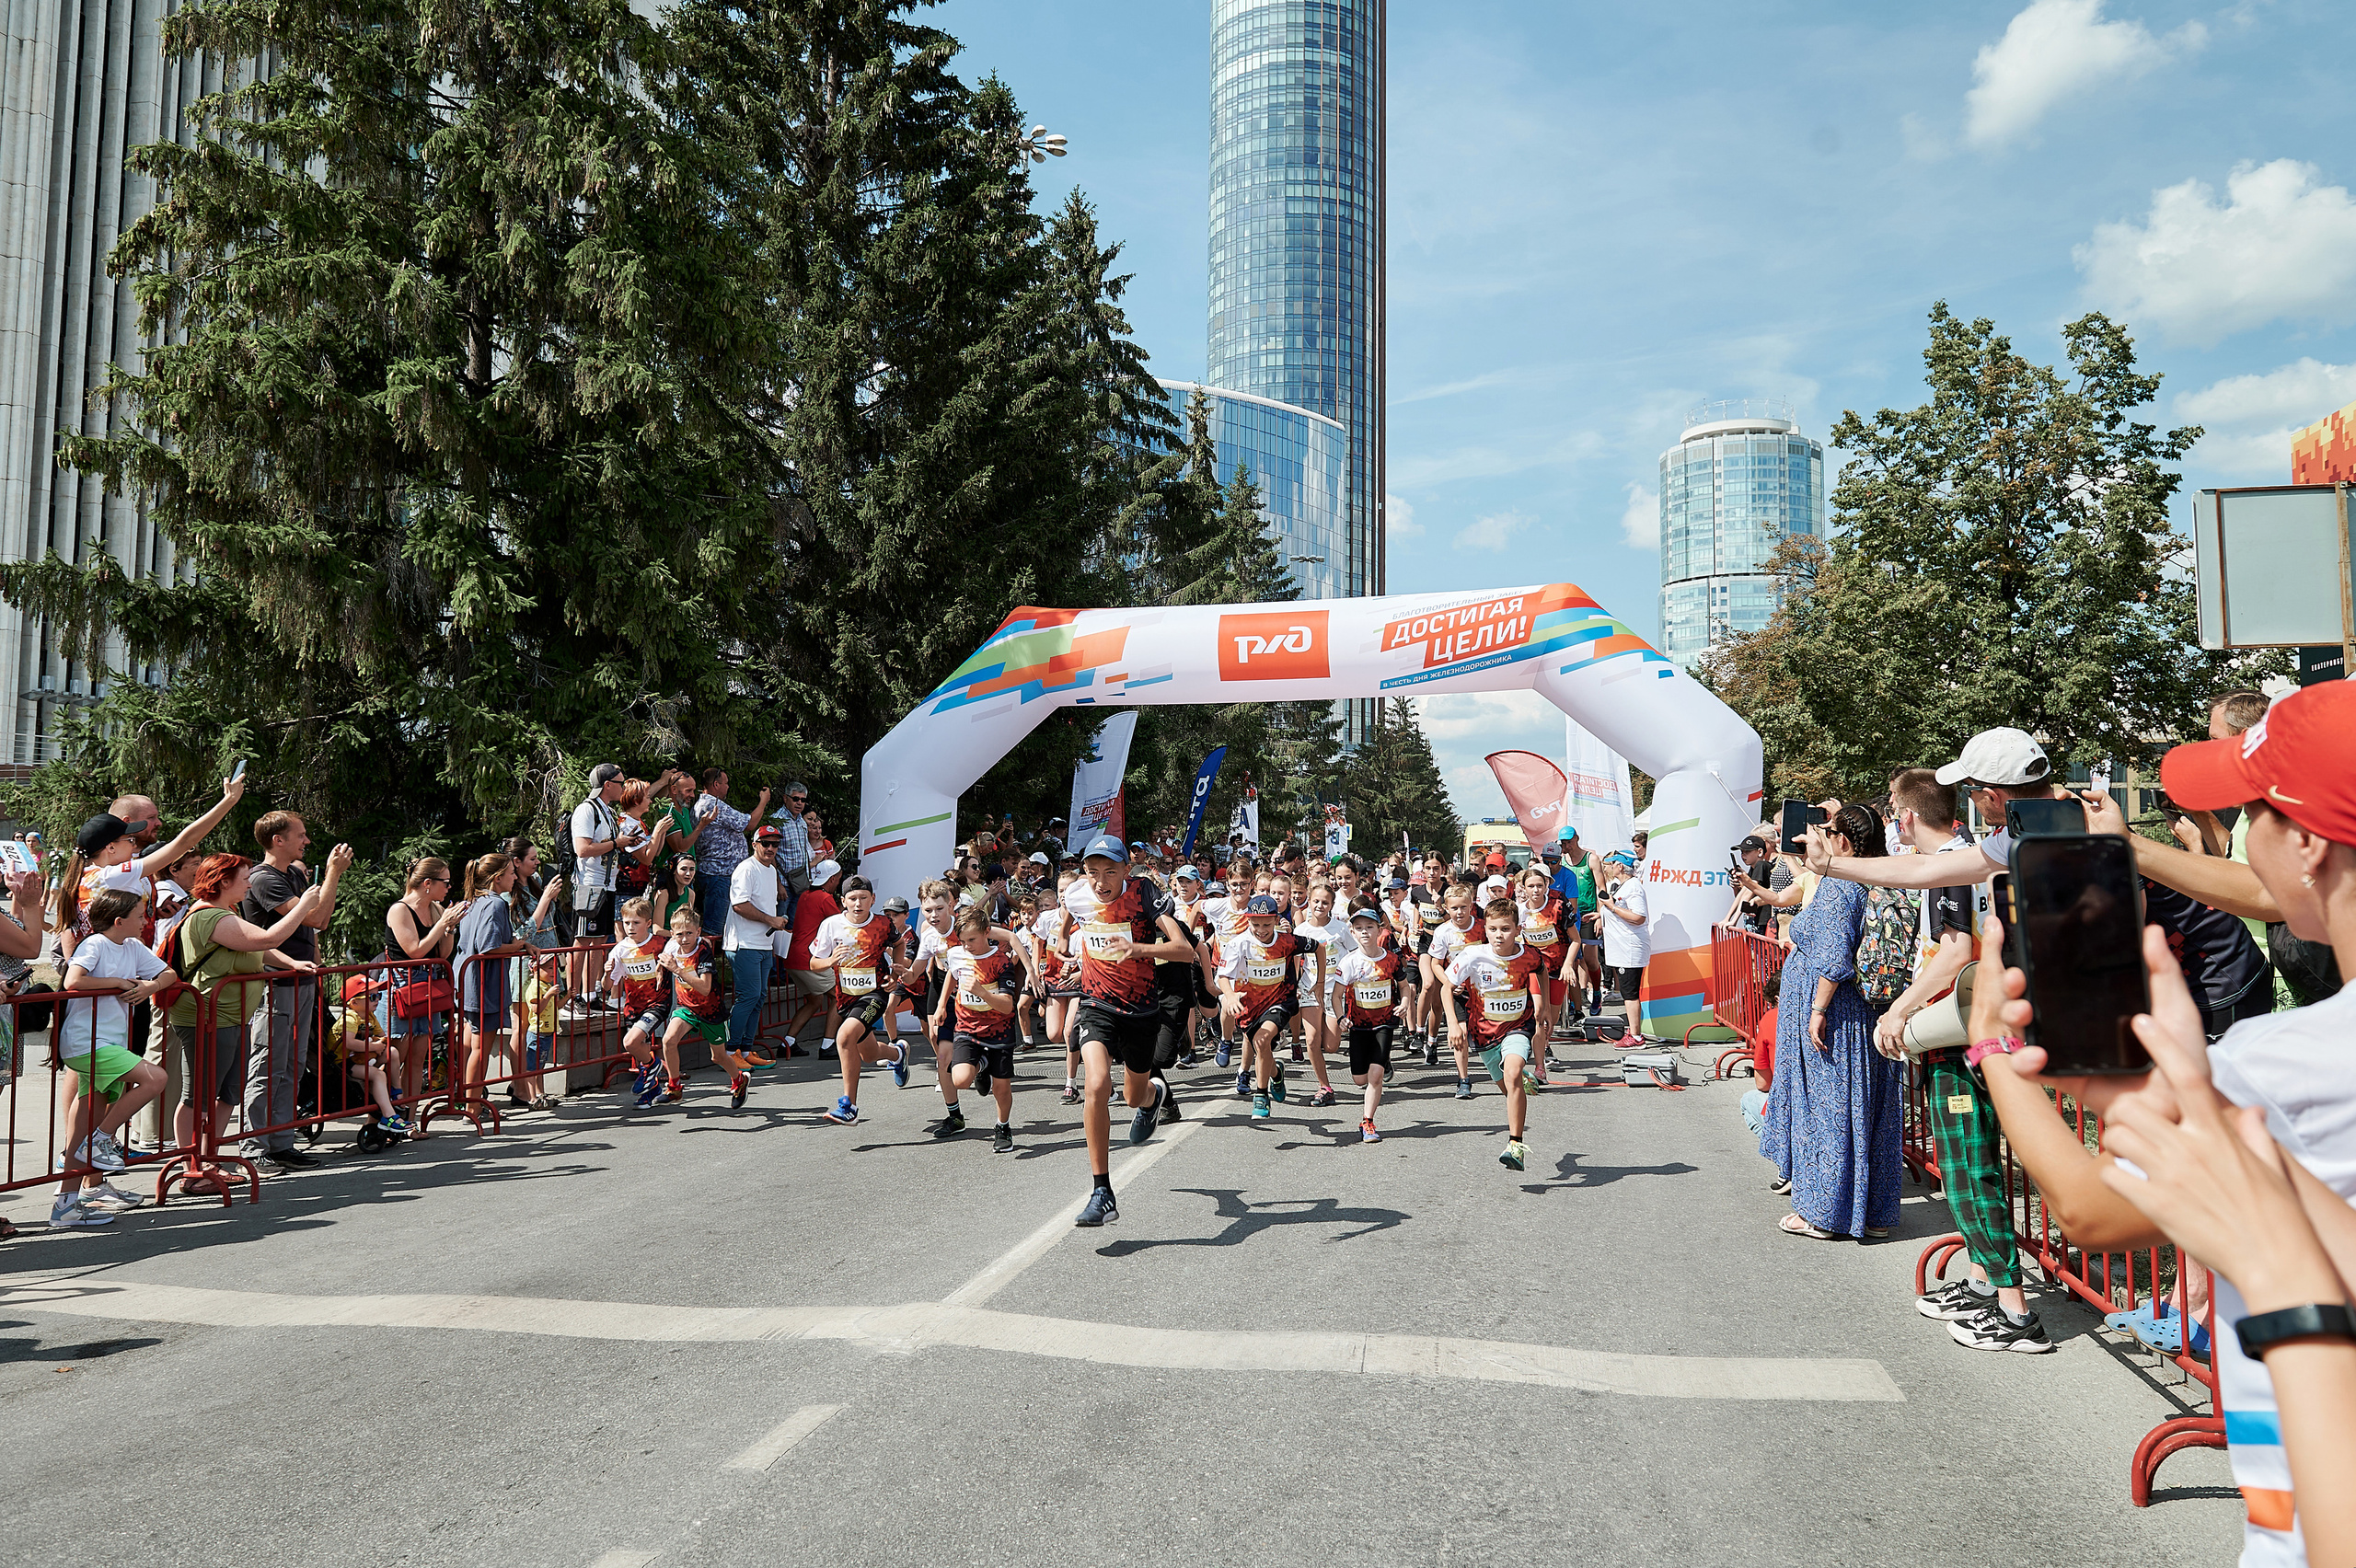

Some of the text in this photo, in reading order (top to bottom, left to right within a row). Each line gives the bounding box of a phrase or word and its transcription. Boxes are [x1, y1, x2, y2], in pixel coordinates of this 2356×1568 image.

[1392, 594, 1495, 620] БЛАГОТВОРИТЕЛЬНЫЙ
[1391, 596, 1524, 648] ДОСТИГАЯ
[1433, 615, 1528, 662] ЦЕЛИ!
[1390, 677, 1412, 686] ЧЕСТЬ
[1413, 674, 1428, 683] ДНЯ
[1430, 654, 1513, 679] ЖЕЛЕЗНОДОРОЖНИКА
[2311, 657, 2343, 672] ЕКАТЕРИНБУ
[1529, 931, 1553, 941] 11259
[627, 963, 653, 974] 11133
[1253, 967, 1281, 977] 11281
[842, 976, 872, 986] 11084
[1359, 989, 1387, 1000] 11261
[1489, 999, 1523, 1012] 11055
